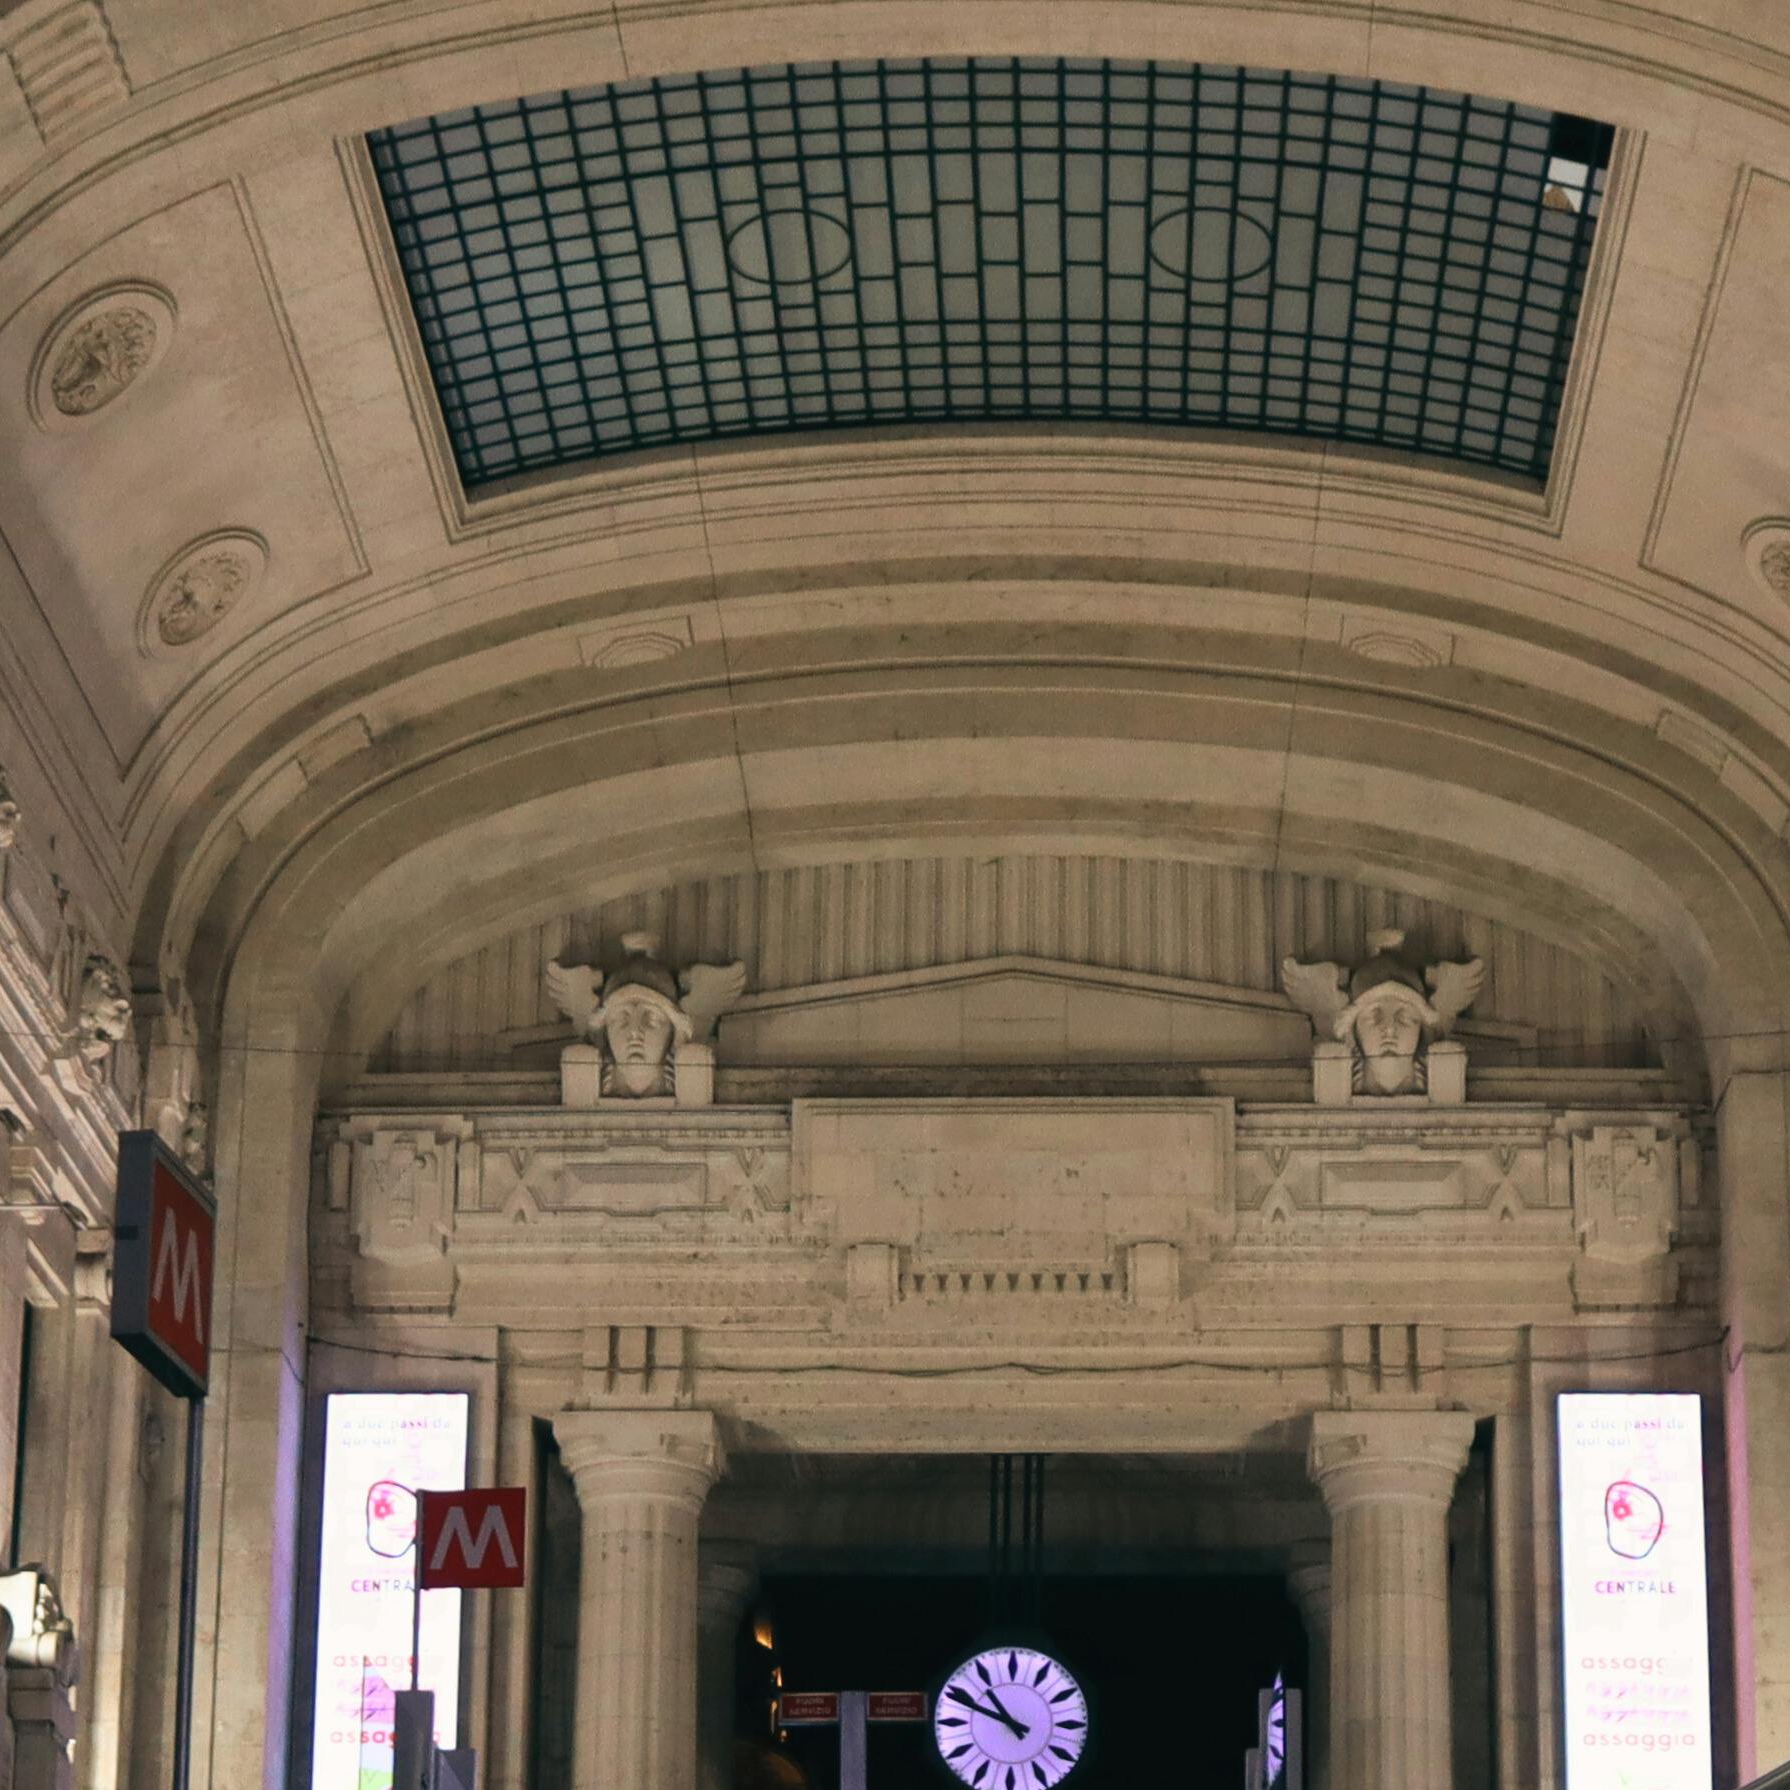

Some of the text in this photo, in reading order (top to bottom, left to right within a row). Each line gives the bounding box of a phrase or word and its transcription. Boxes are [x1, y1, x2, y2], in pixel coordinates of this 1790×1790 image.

[152, 1206, 203, 1345] M
[429, 1504, 518, 1570] M
[351, 1579, 414, 1593] CENTRA
[1595, 1580, 1676, 1594] CENTRALE
[1583, 1732, 1696, 1751] assaggia
